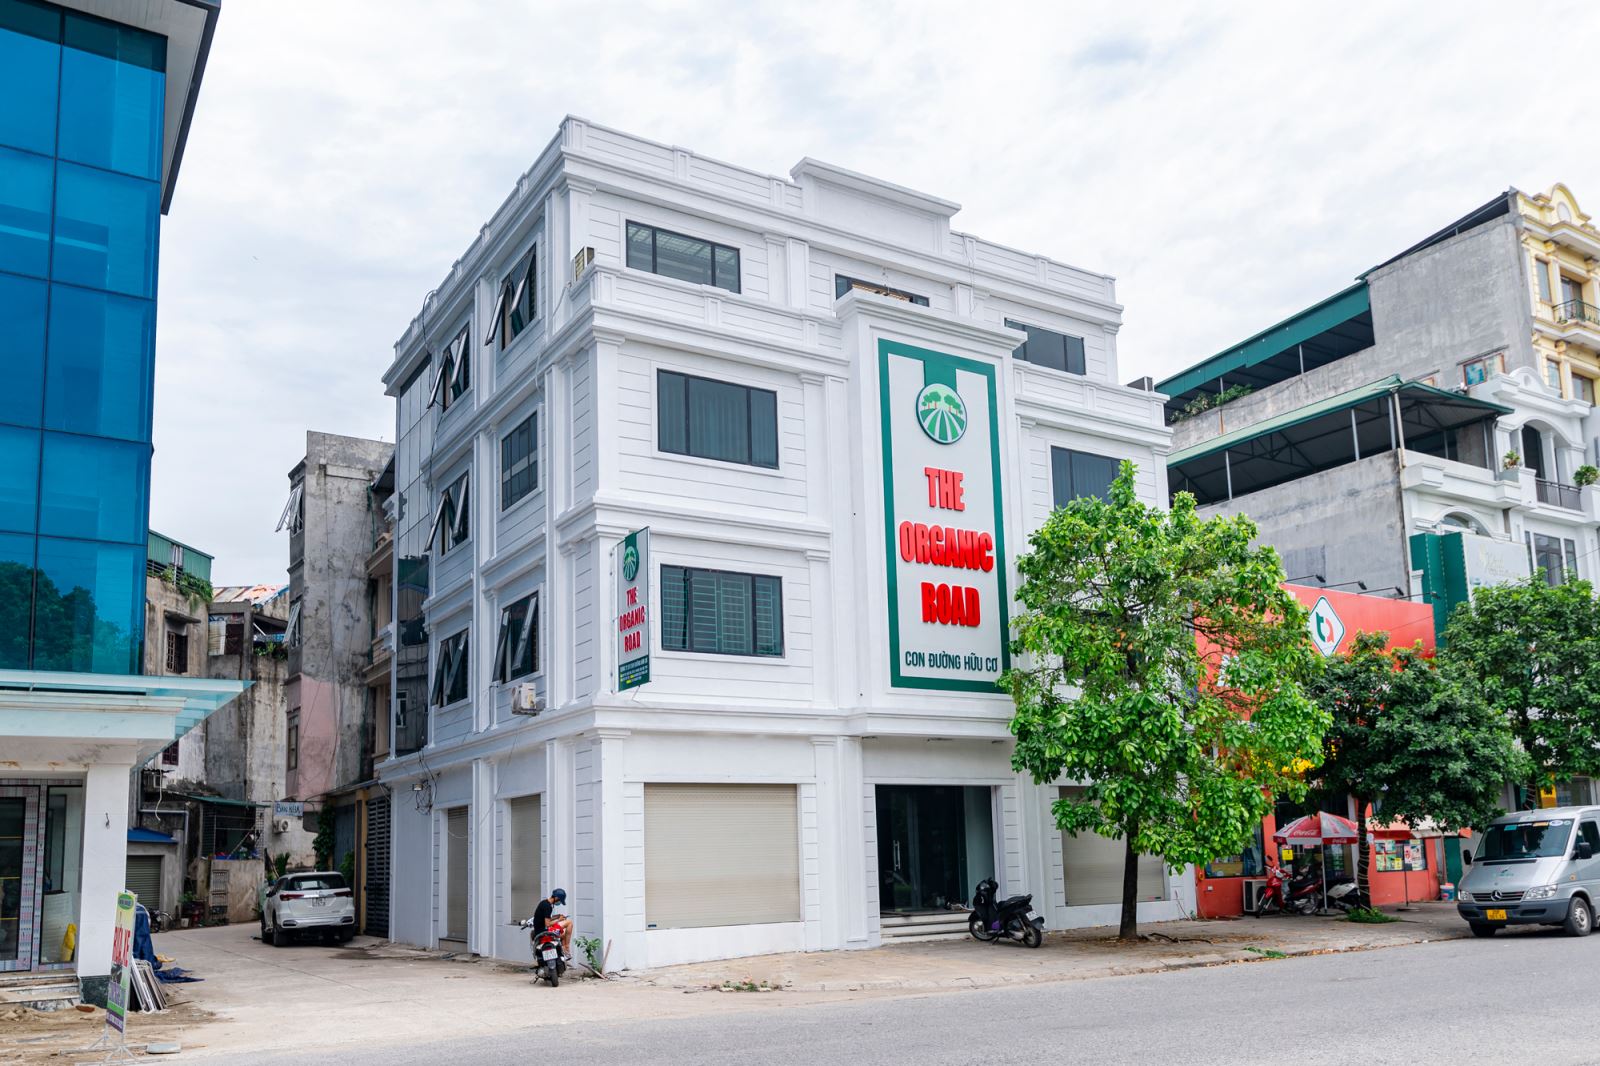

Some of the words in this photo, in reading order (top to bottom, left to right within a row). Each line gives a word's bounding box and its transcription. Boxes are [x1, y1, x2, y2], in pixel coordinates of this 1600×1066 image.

[925, 467, 965, 511] THE
[900, 521, 994, 572] ORGANIC
[626, 586, 638, 607] THE
[921, 582, 980, 627] ROAD
[619, 605, 645, 632] ORGANIC
[624, 631, 641, 653] ROAD
[905, 651, 925, 667] CON
[963, 652, 983, 672] HỮU
[985, 657, 998, 673] CƠ
